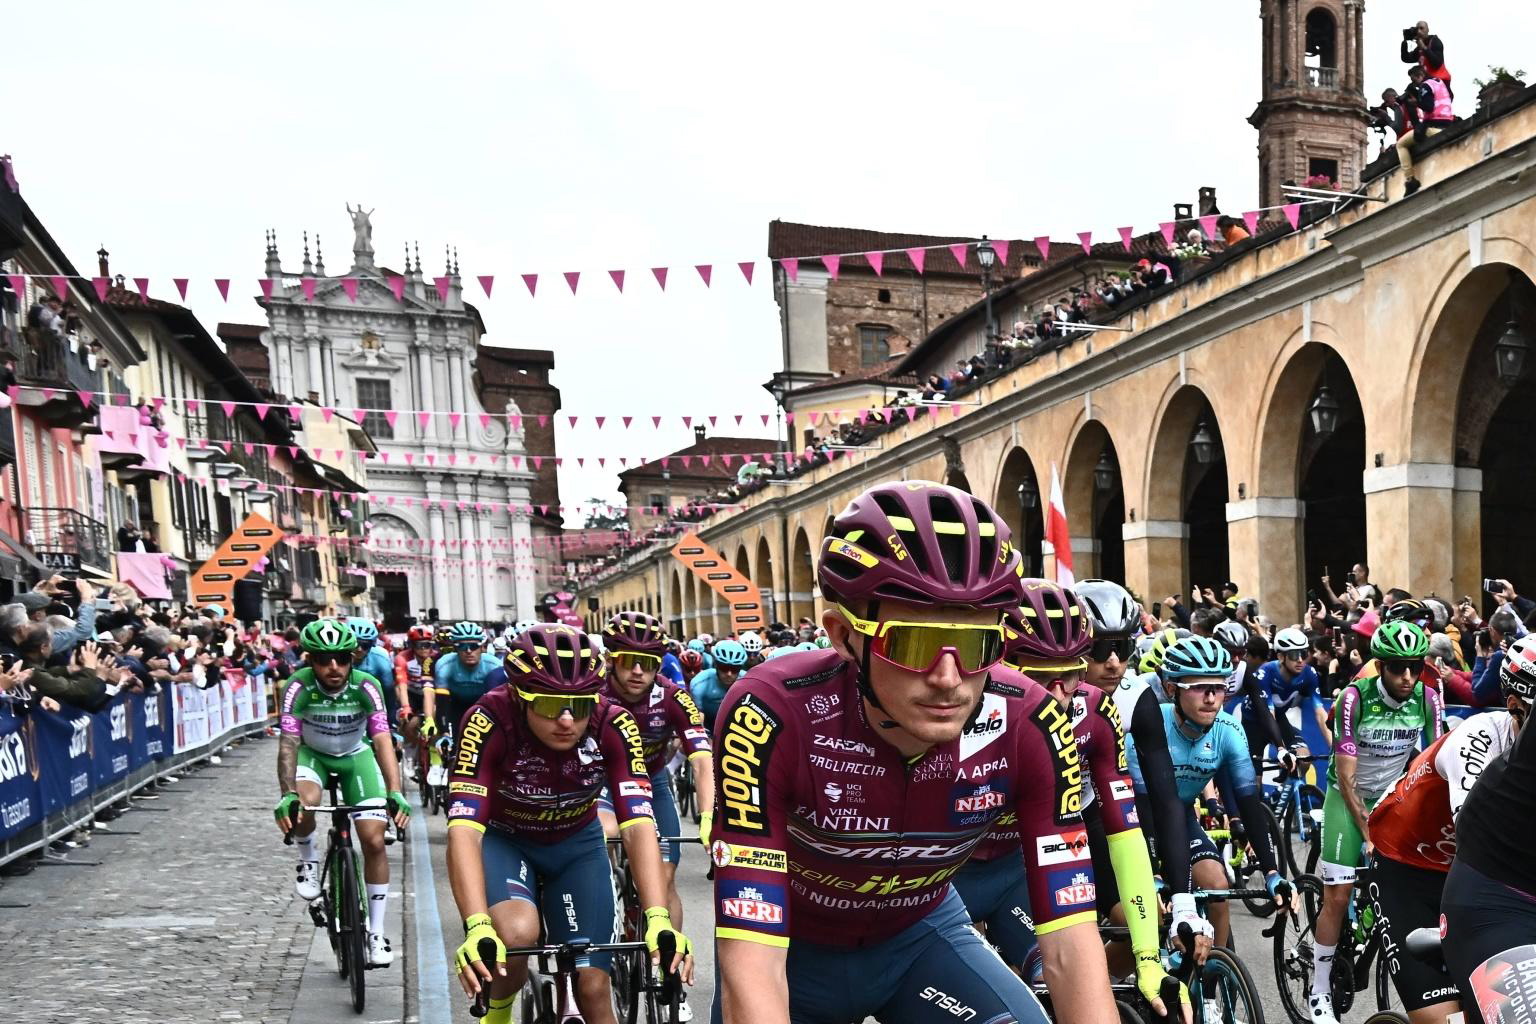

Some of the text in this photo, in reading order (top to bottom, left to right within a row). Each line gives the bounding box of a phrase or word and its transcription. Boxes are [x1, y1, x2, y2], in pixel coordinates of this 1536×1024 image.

[887, 534, 907, 561] LAS
[42, 554, 74, 567] BAR
[962, 715, 1003, 737] velo
[829, 807, 858, 816] VINI
[957, 792, 1005, 812] NERI
[794, 806, 891, 831] FANTINI
[734, 856, 786, 870] SPECIALIST
[752, 850, 785, 861] SPORT
[562, 893, 579, 932] URSUS
[723, 899, 783, 923] NERI
[1369, 881, 1401, 976] Cofidis
[919, 985, 977, 1022] URSUS
